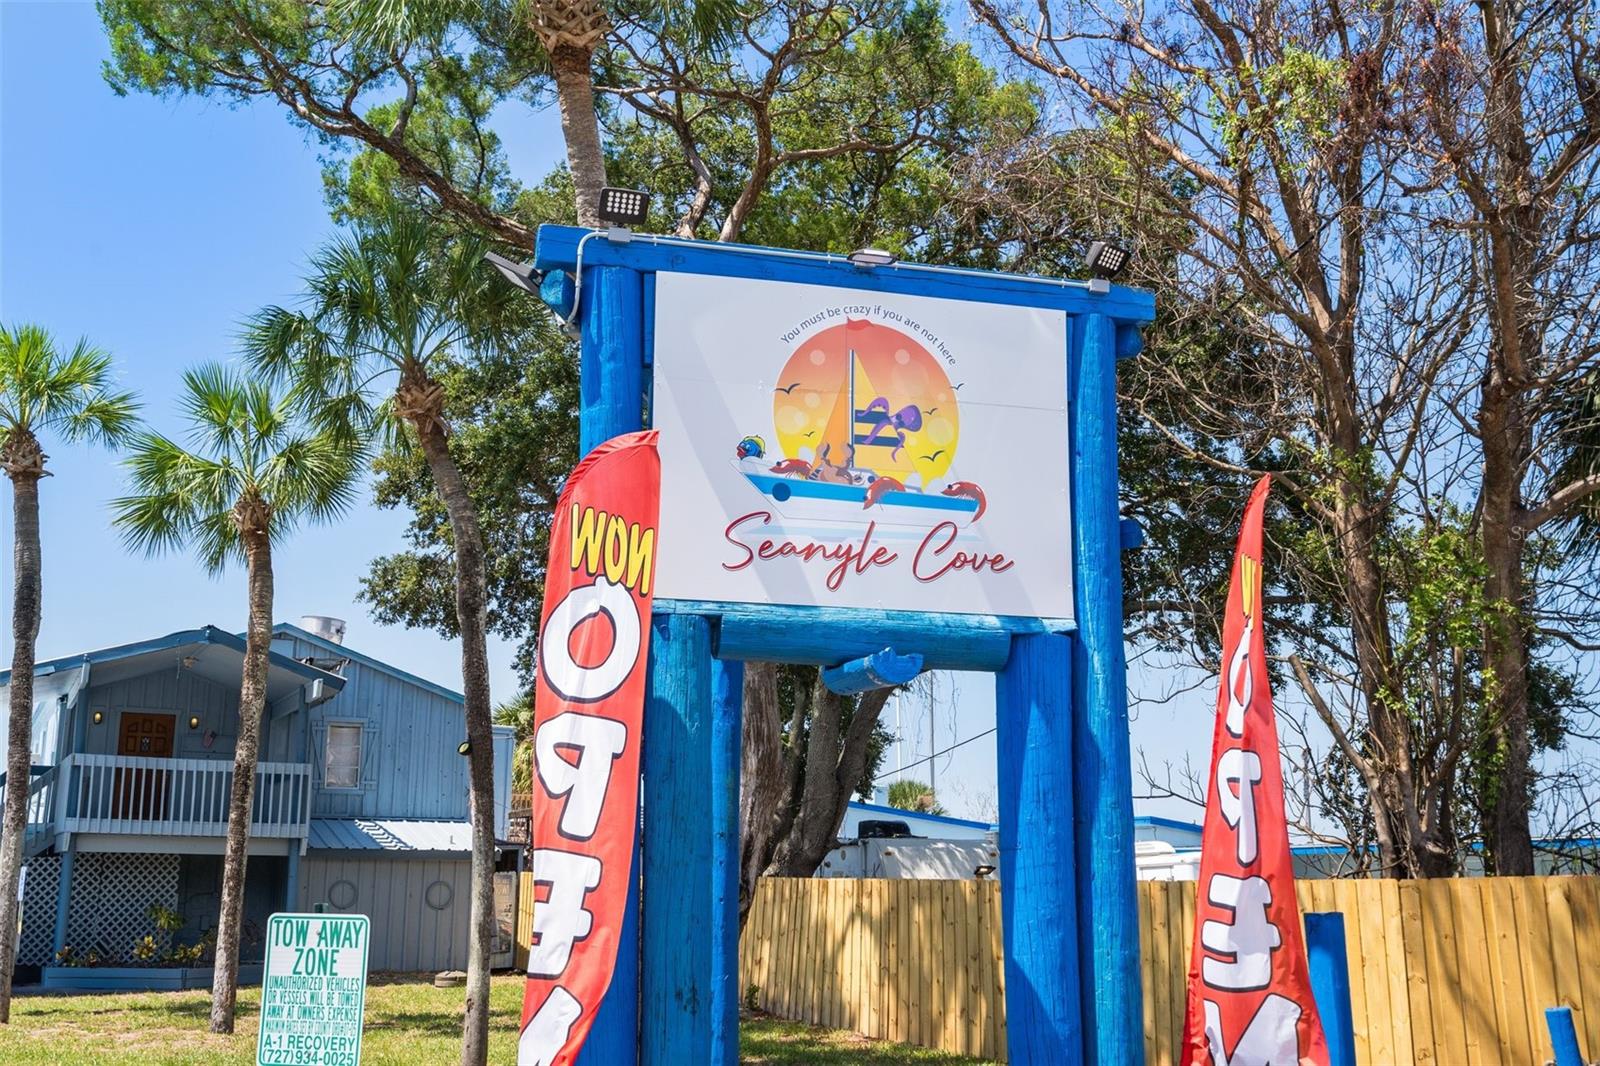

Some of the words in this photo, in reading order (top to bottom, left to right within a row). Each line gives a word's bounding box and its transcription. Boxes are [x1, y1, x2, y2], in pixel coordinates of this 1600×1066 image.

[780, 327, 801, 344] You
[801, 312, 826, 331] must
[827, 305, 841, 318] be
[843, 305, 871, 317] crazy
[873, 304, 882, 315] if
[882, 307, 903, 323] you
[904, 317, 920, 332] are
[921, 328, 938, 344] not
[937, 341, 956, 366] here
[721, 511, 898, 592] Seanyle
[912, 520, 1015, 583] Cove
[274, 919, 310, 947] TOW
[317, 920, 364, 948] AWAY
[292, 947, 340, 977] ZONE
[269, 976, 323, 990] UNAUTHORIZED
[326, 977, 360, 992] VEHICLES
[268, 990, 277, 1004] OR
[280, 990, 307, 1005] VESSELS
[310, 991, 324, 1006] WILL
[327, 991, 335, 1006] BE
[338, 992, 359, 1007] TOWED
[267, 1004, 284, 1018] AWAY
[287, 1005, 295, 1018] AT
[297, 1005, 325, 1020] OWNERS
[328, 1006, 357, 1022] EXPENSE
[264, 1034, 283, 1049] A-1
[287, 1035, 356, 1051] RECOVERY
[262, 1049, 354, 1066] (727)934-0025
